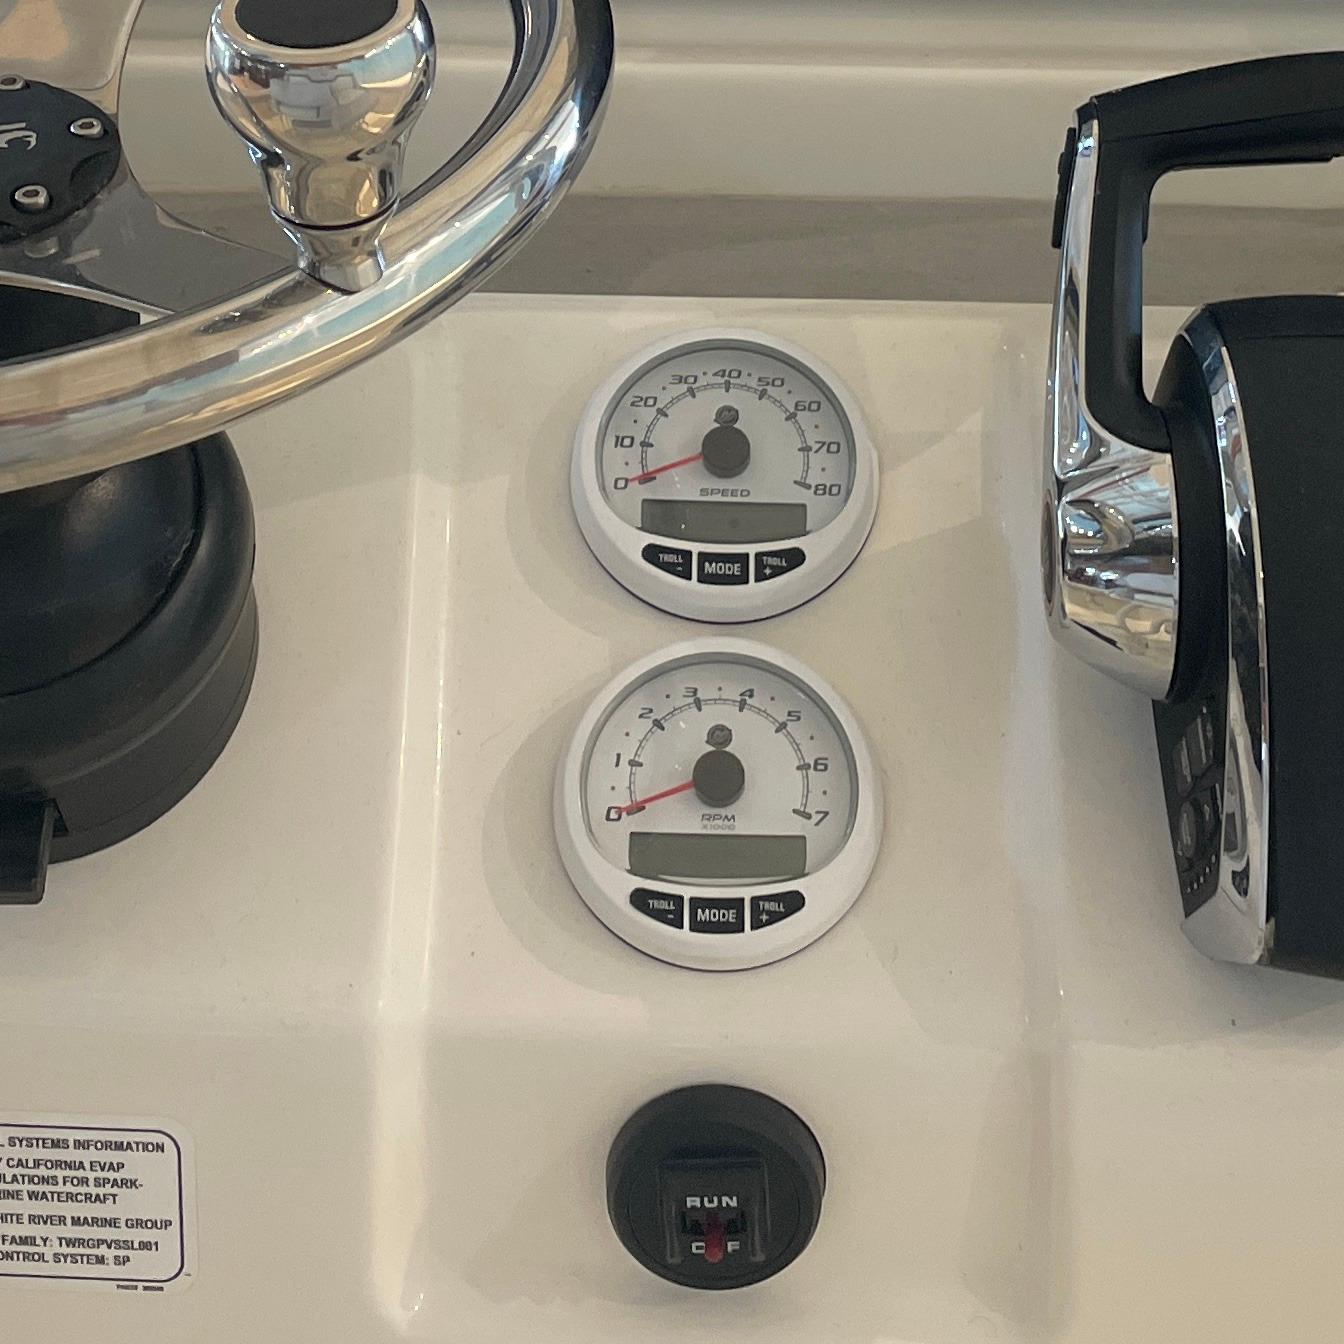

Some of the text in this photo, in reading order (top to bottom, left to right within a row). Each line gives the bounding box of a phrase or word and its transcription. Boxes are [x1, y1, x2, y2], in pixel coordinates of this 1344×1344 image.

[669, 374, 698, 385] 30
[712, 368, 742, 380] 40
[757, 376, 785, 388] 50
[630, 396, 658, 408] 20
[793, 400, 822, 413] 60
[613, 435, 635, 449] 10
[813, 441, 841, 454] 70
[613, 476, 629, 491] 0
[813, 483, 842, 497] 80
[699, 487, 751, 499] SPEED
[762, 556, 787, 567] TROLL
[704, 562, 741, 576] MODE
[682, 687, 698, 698] 3
[739, 688, 755, 699] 4
[638, 707, 654, 720] 2
[786, 710, 802, 722] 5
[613, 752, 622, 768] 1
[812, 757, 829, 772] 6
[605, 806, 623, 822] 0
[701, 813, 736, 823] RPM
[813, 810, 830, 827] 7
[648, 899, 676, 910] TROLL
[759, 901, 785, 913] TROLL
[697, 908, 737, 923] MODE
[8, 1136, 70, 1150] SYSTEMS
[74, 1139, 165, 1154] INFORMATION
[6, 1157, 86, 1172] CALIFORNIA
[90, 1160, 125, 1173] EVAP
[63, 1175, 90, 1188] FOR
[94, 1177, 144, 1190] SPARK-
[27, 1190, 118, 1205] WATERCRAFT
[686, 1195, 738, 1209] RUN
[28, 1214, 68, 1226] RIVER
[71, 1216, 122, 1229] MARINE
[125, 1218, 173, 1231] GROUP
[1, 1234, 53, 1248] FAMILY:
[691, 1241, 741, 1254] OF
[53, 1252, 110, 1266] SYSTEM:
[113, 1255, 131, 1267] SP
